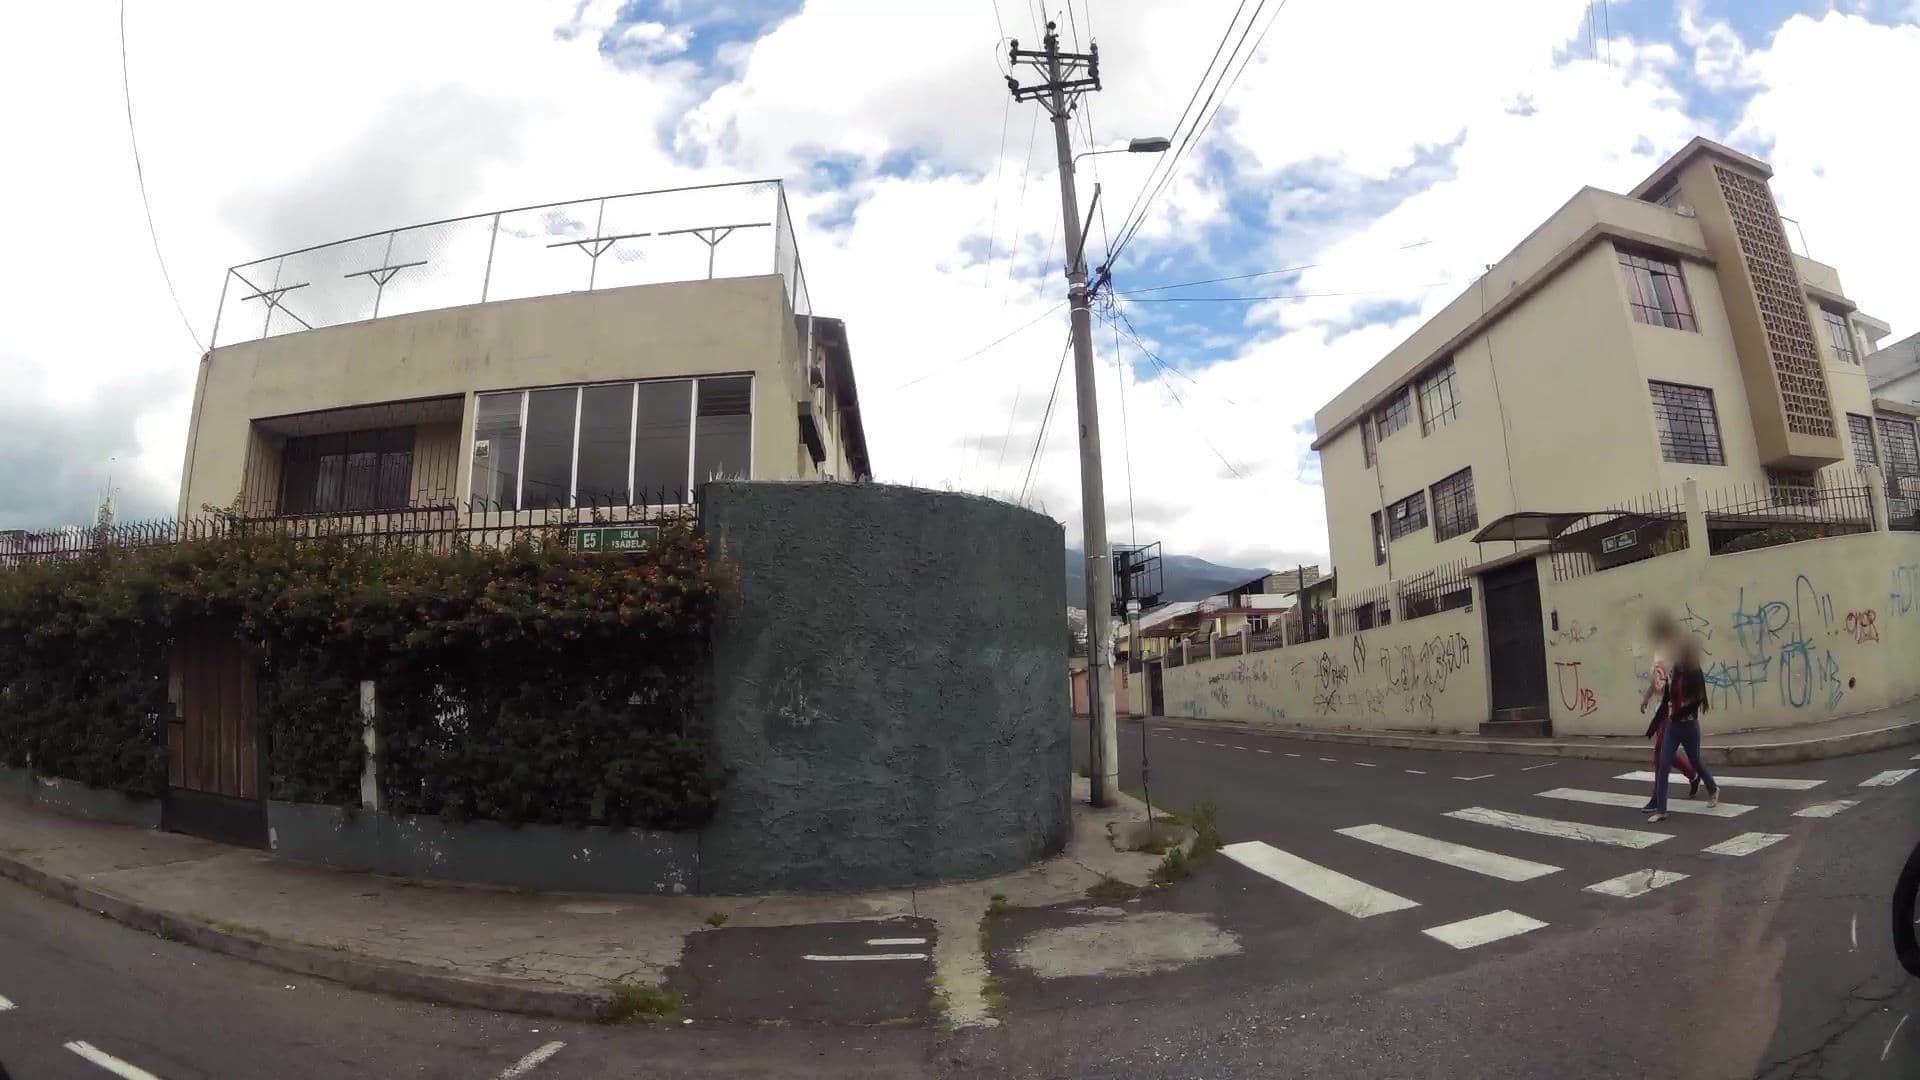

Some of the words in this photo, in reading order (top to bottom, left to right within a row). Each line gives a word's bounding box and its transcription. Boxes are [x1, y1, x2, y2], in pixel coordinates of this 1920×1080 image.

[620, 530, 639, 539] ISLA
[583, 532, 597, 548] E5
[611, 540, 647, 549] ISABELA
